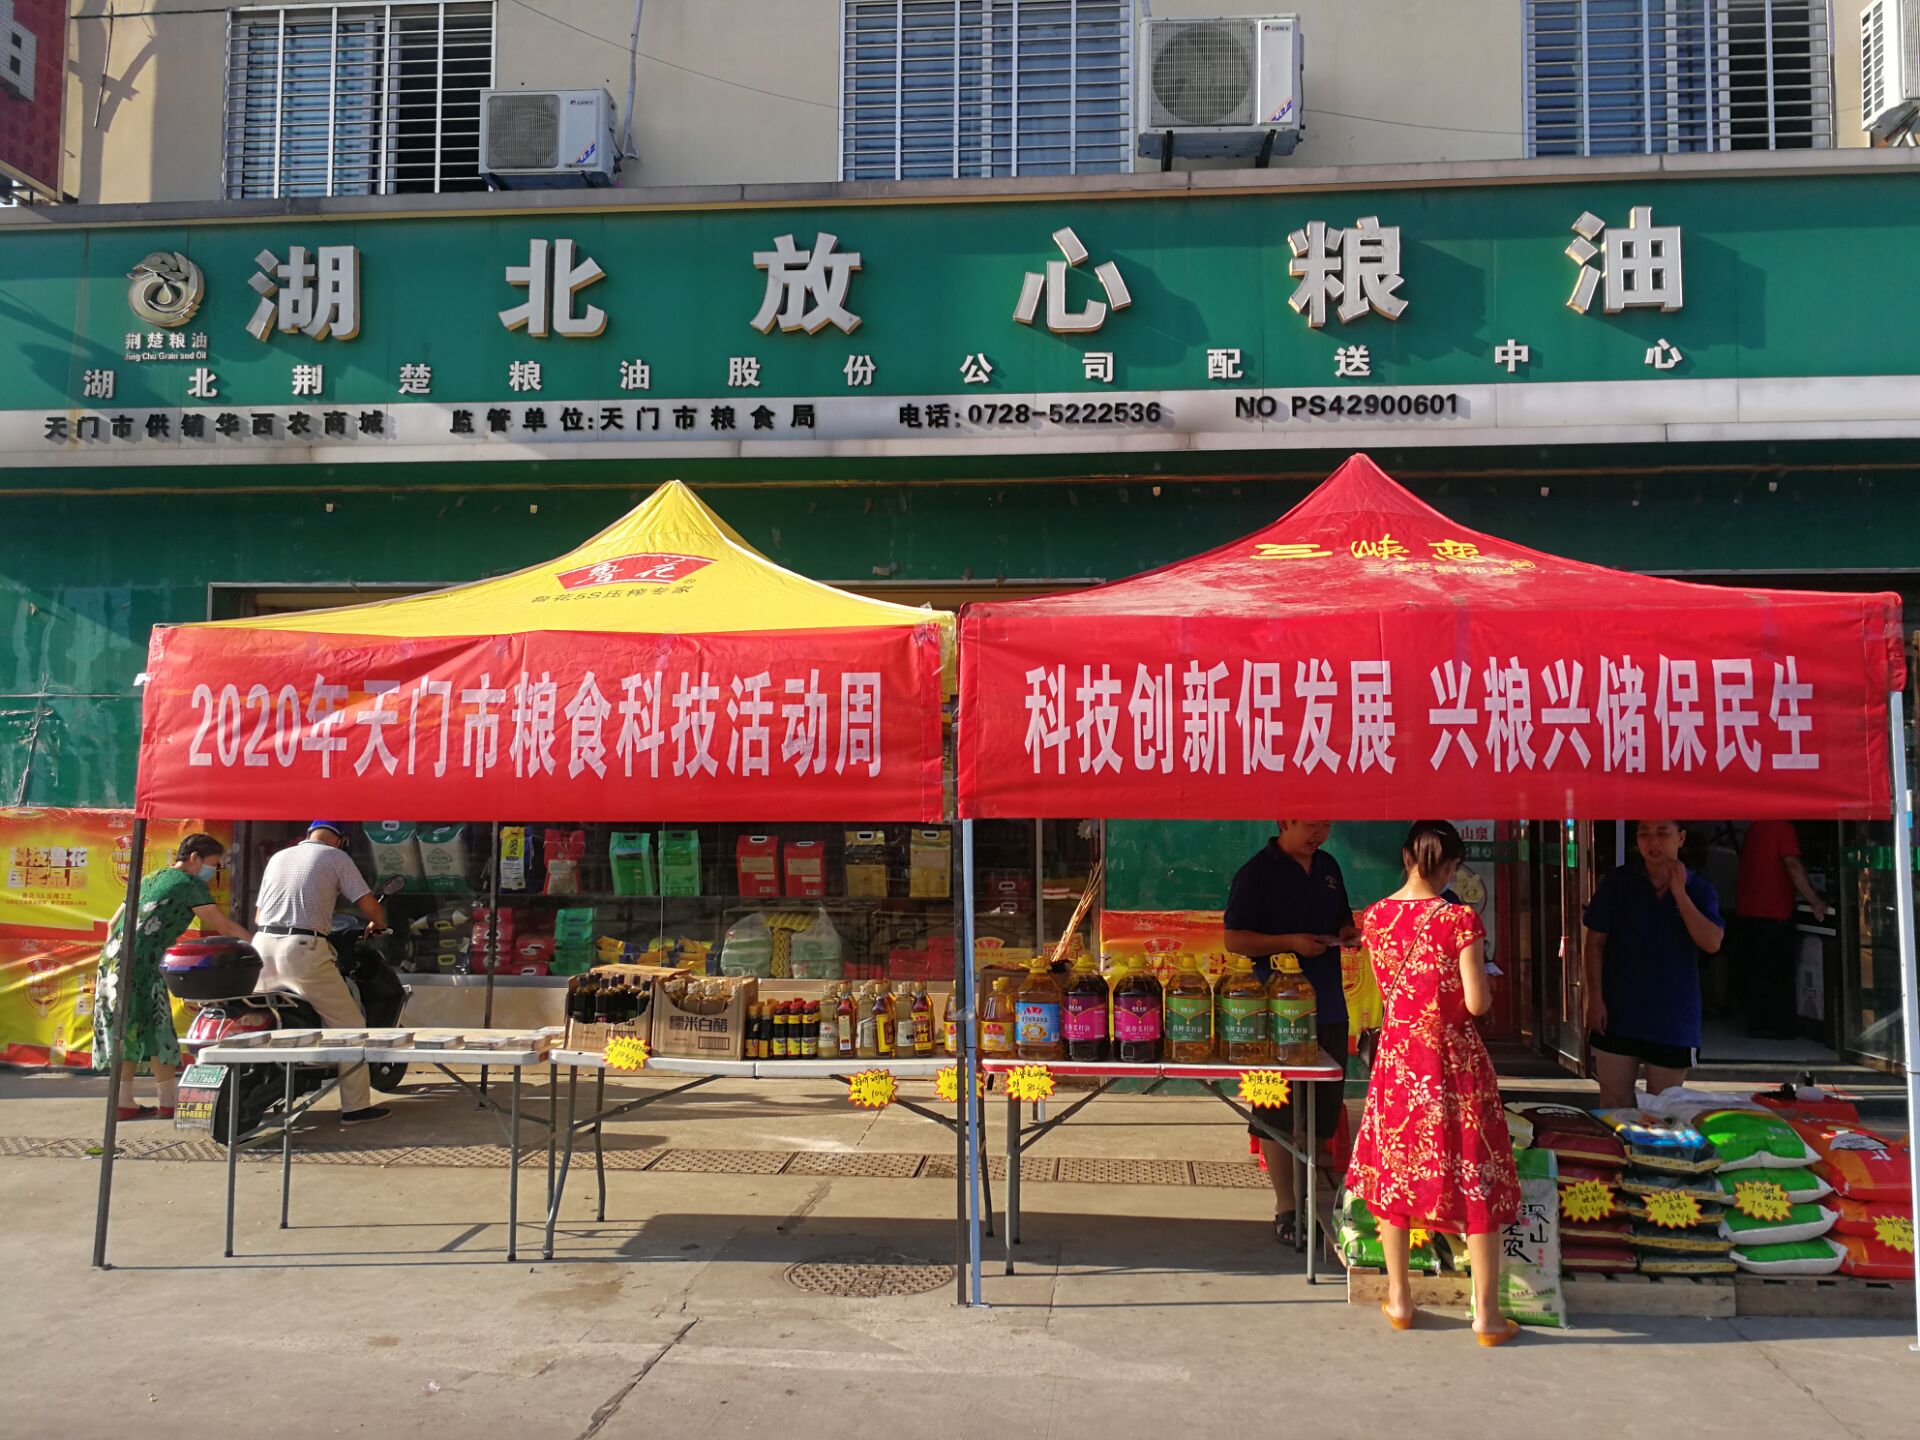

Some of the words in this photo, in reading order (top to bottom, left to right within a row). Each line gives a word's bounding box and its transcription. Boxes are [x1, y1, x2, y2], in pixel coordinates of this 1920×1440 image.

[246, 205, 1685, 343] 湖北放心粮油
[125, 331, 208, 349] 荆楚粮油
[142, 352, 157, 360] Chu
[158, 352, 178, 360] Grain
[180, 352, 194, 360] and
[195, 351, 207, 359] Oil
[83, 338, 1683, 400] 湖北荆楚粮油股份公司配送中心
[43, 409, 385, 440] 天门市供销华西农商城
[899, 402, 1162, 430] 电话:0728-5222536
[1234, 395, 1277, 418] NO
[1291, 393, 1459, 417] PS42900601
[187, 668, 883, 780] 2020年天门市粮食科技活动周
[1024, 658, 1398, 776] 科技创新促发展
[1427, 655, 1820, 775] 兴粮兴储保民生
